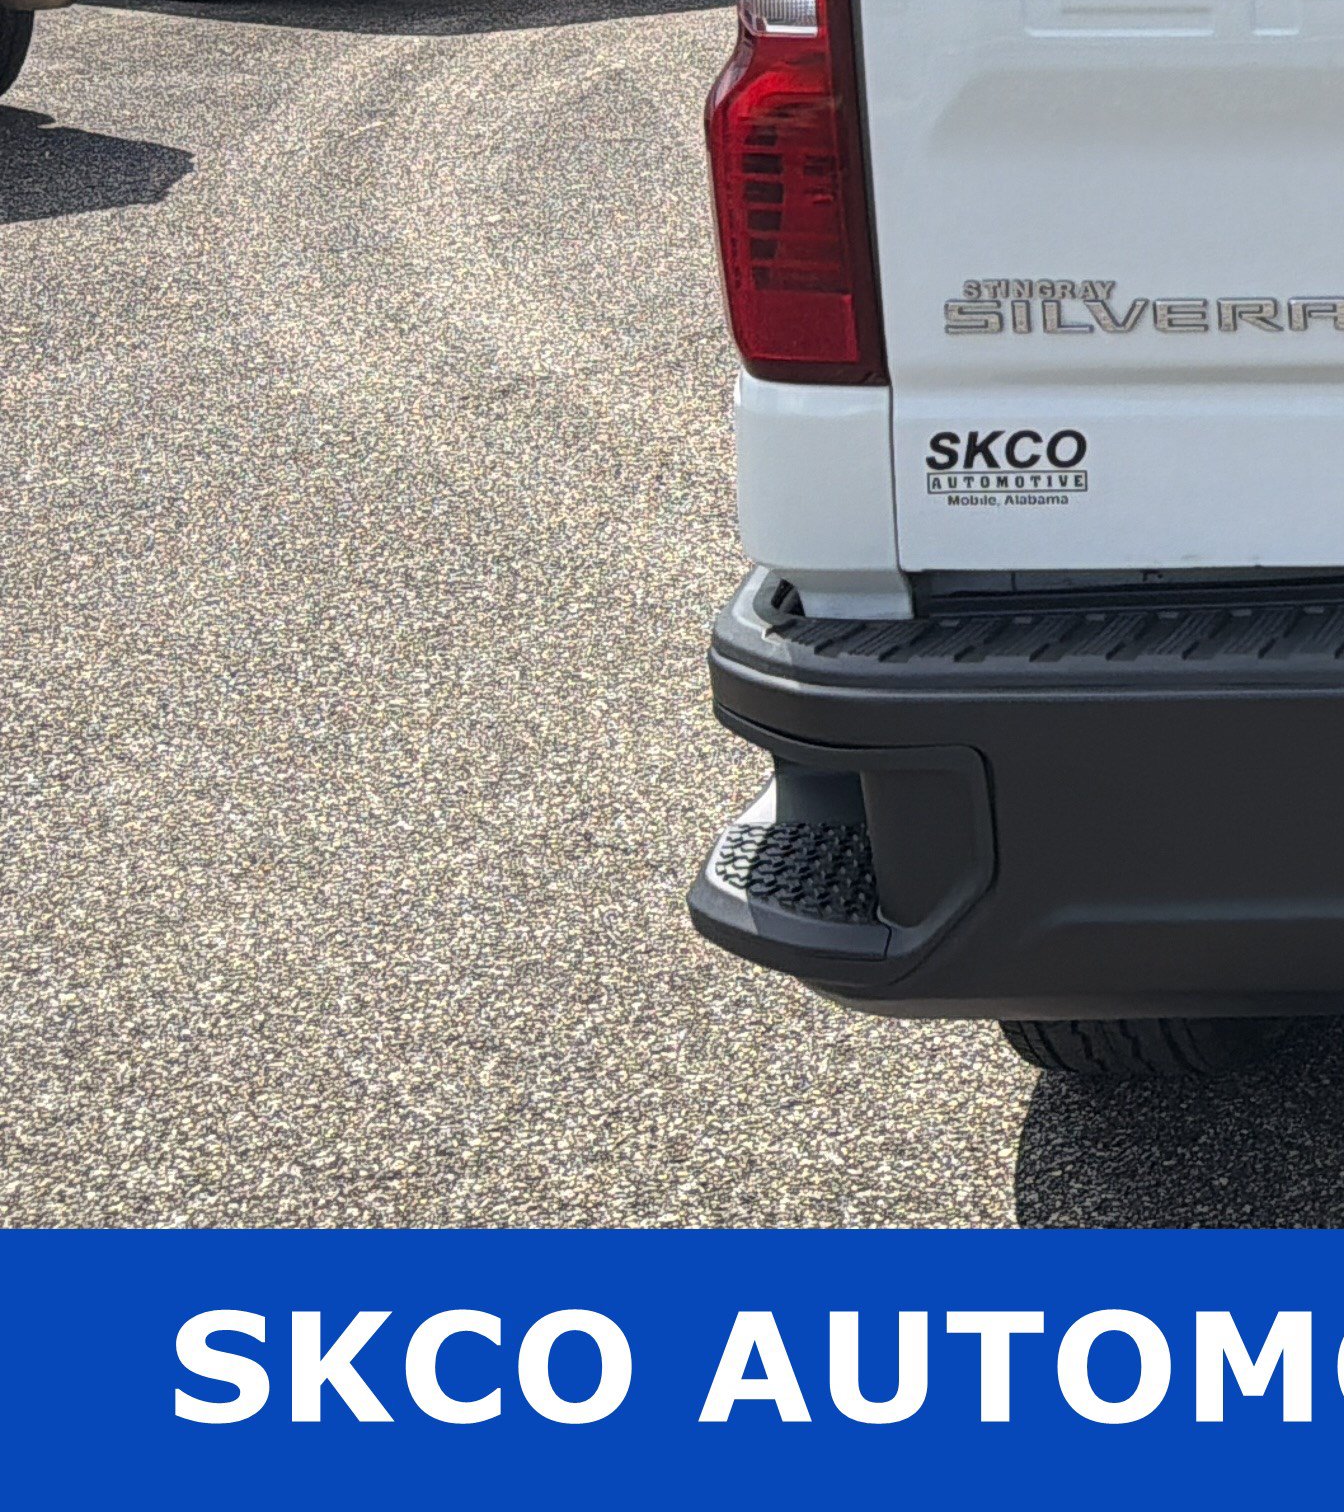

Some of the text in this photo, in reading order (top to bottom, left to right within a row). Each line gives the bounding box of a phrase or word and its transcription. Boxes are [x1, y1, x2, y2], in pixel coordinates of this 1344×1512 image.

[963, 279, 1116, 301] STINGRAY
[925, 430, 1087, 470] SKCO
[931, 474, 1084, 489] AUTOMOTIVE
[948, 494, 1069, 506] Mobile, Alabama
